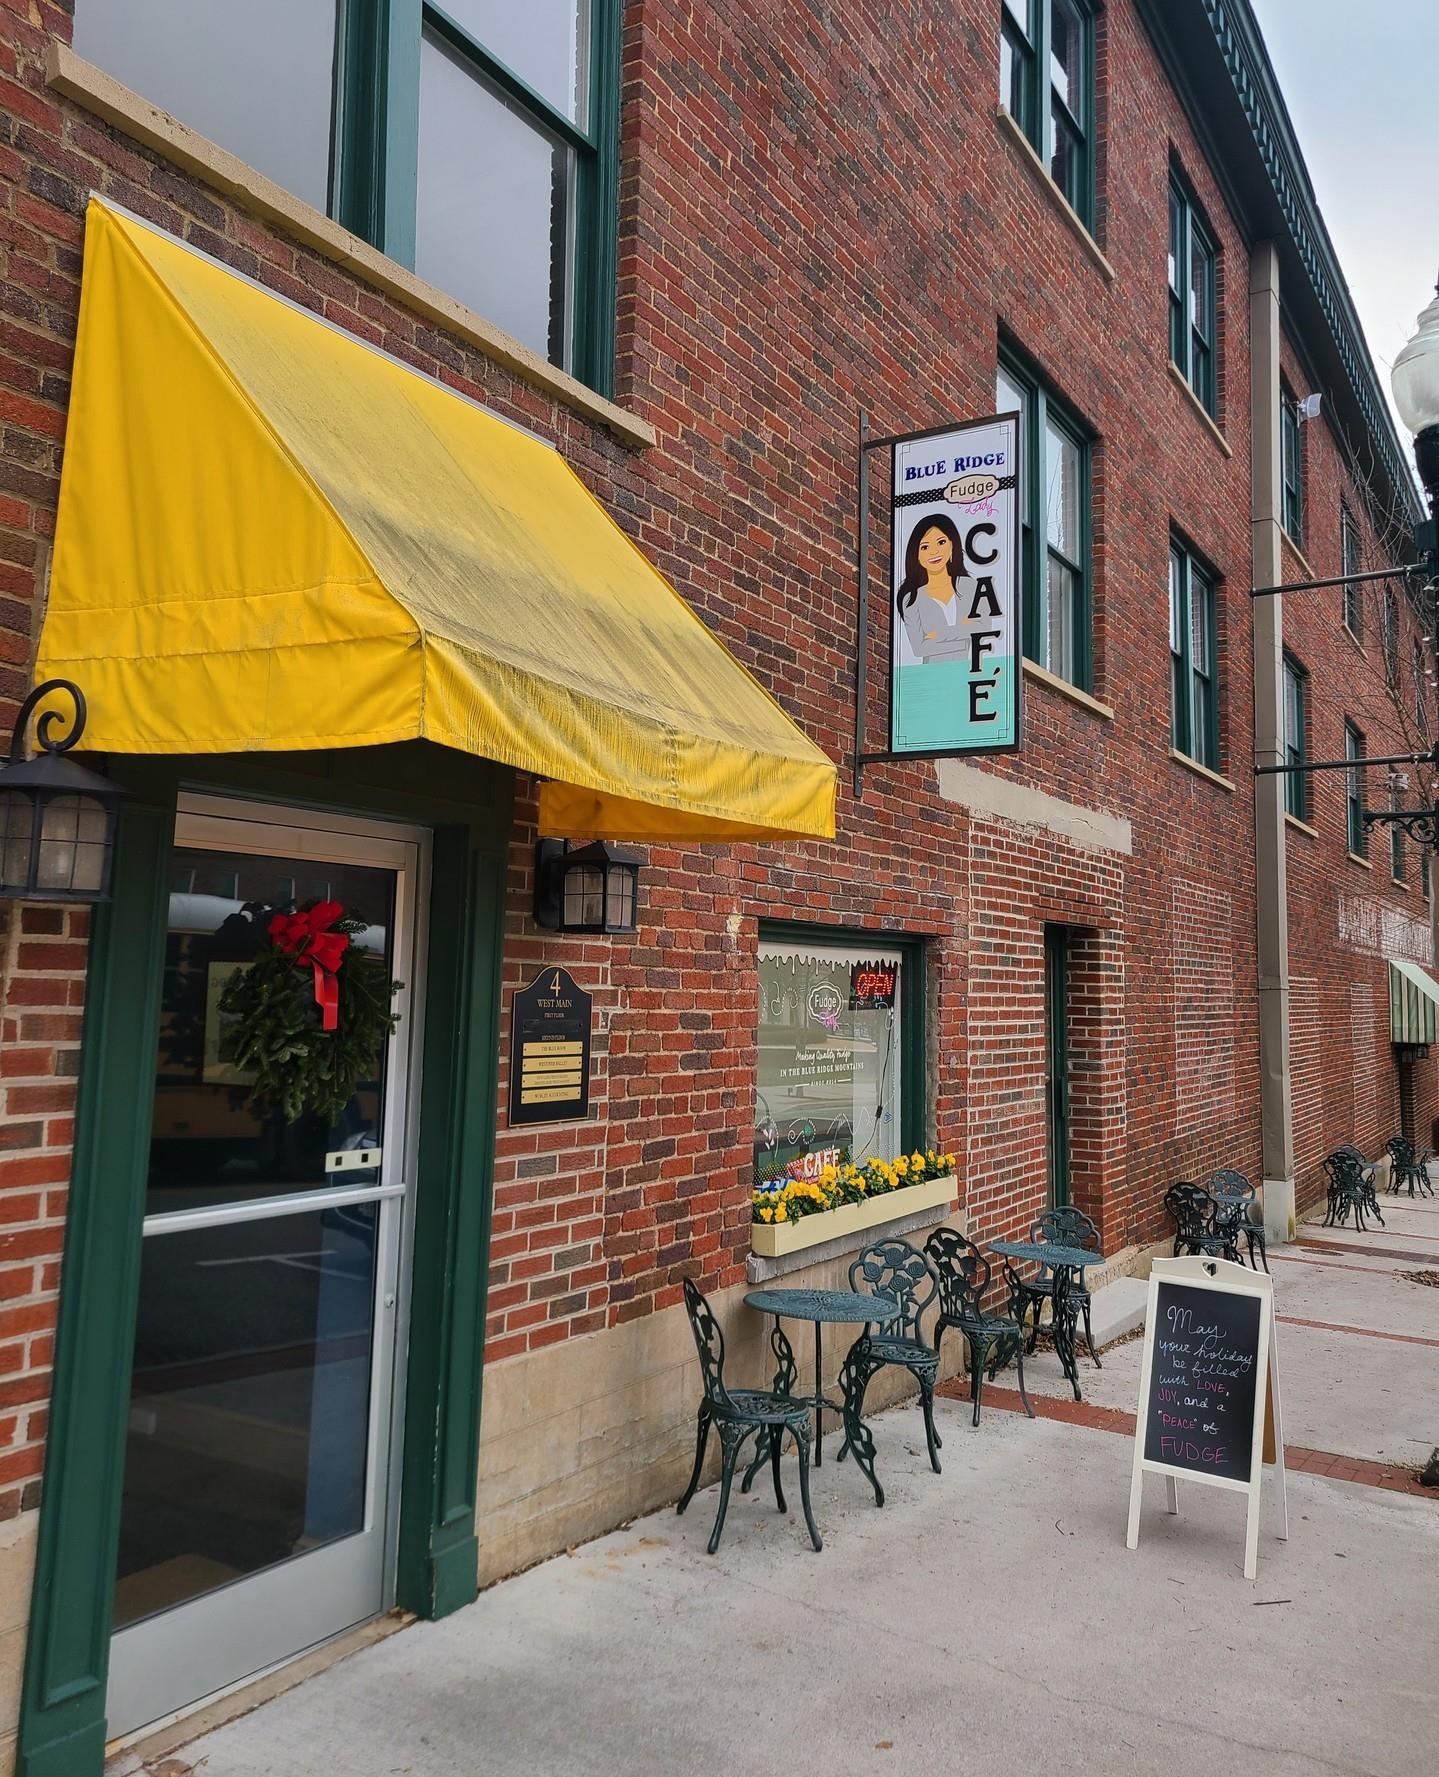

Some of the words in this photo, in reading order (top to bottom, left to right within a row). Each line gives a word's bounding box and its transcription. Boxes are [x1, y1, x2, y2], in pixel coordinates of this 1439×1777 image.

[904, 459, 947, 481] BLUE
[953, 452, 1005, 473] RIDGE
[950, 481, 994, 498] Fudge
[964, 522, 1003, 724] CAFÉ
[550, 970, 561, 998] 4
[856, 973, 894, 997] OPEN
[537, 999, 555, 1008] WEST
[555, 999, 573, 1008] MAIN
[814, 994, 837, 1011] Fudge
[795, 1050, 816, 1065] Making
[816, 1048, 836, 1062] Quality
[780, 1069, 787, 1077] IN
[788, 1068, 800, 1077] THE
[801, 1066, 816, 1075] BLUE
[816, 1064, 834, 1074] RIDGE
[834, 1061, 864, 1072] MOUNTAINS
[1167, 1305, 1227, 1349] May
[1159, 1340, 1191, 1356] your
[1193, 1344, 1253, 1372] holiday
[1172, 1355, 1187, 1369] be
[1192, 1361, 1240, 1379] filled
[1159, 1374, 1189, 1386] with
[1196, 1379, 1230, 1397] LOVE,
[1158, 1388, 1180, 1406] JOY,
[1184, 1395, 1209, 1409] and
[1216, 1403, 1227, 1412] a
[1202, 1423, 1220, 1435] of
[1160, 1436, 1229, 1464] FUDGE
